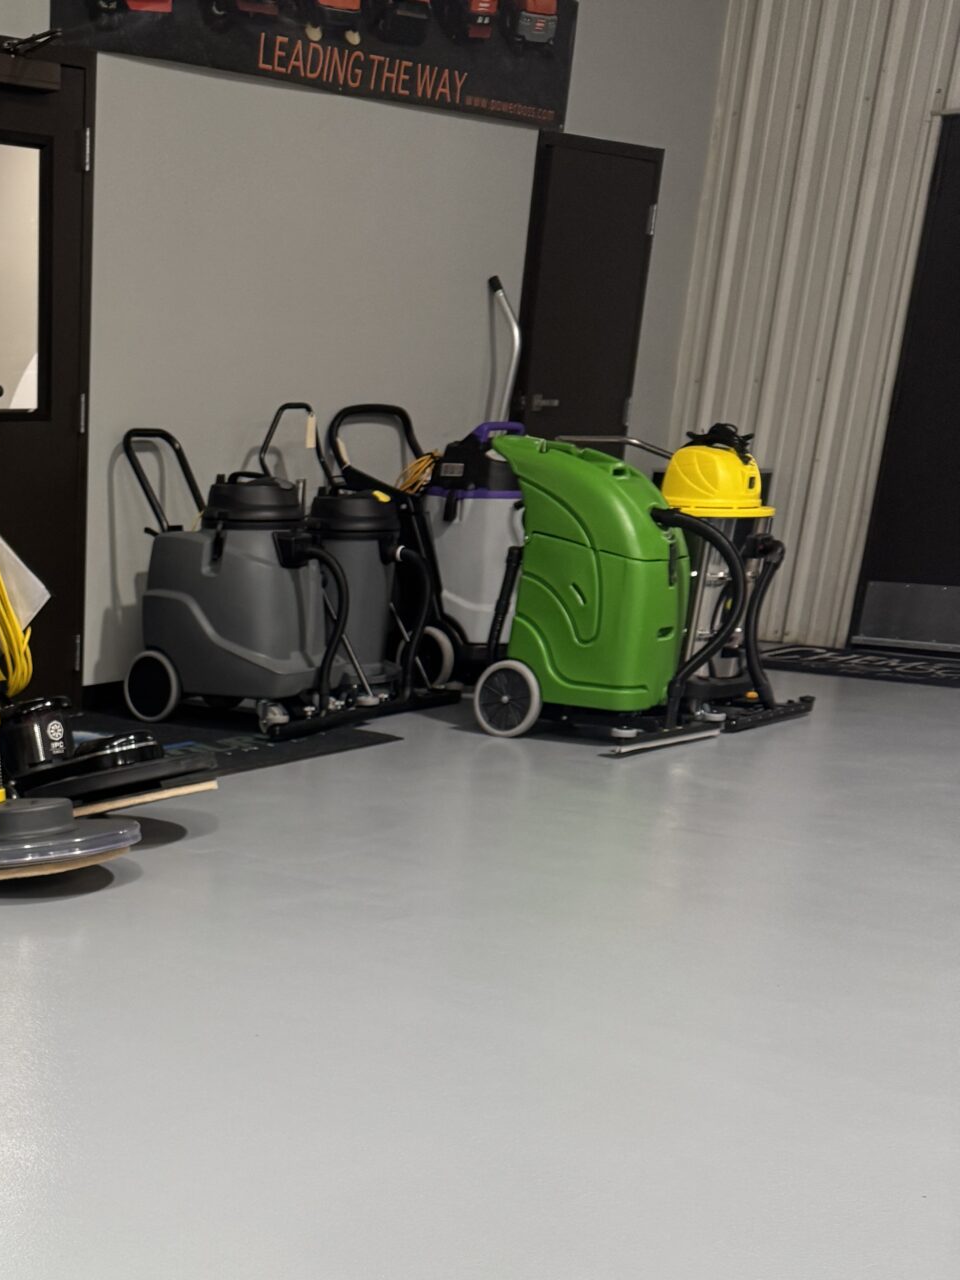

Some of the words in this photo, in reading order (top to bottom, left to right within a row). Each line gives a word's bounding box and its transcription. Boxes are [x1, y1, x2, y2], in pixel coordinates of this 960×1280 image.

[258, 32, 364, 88] LEADING
[369, 54, 413, 95] THE
[416, 63, 468, 104] WAY
